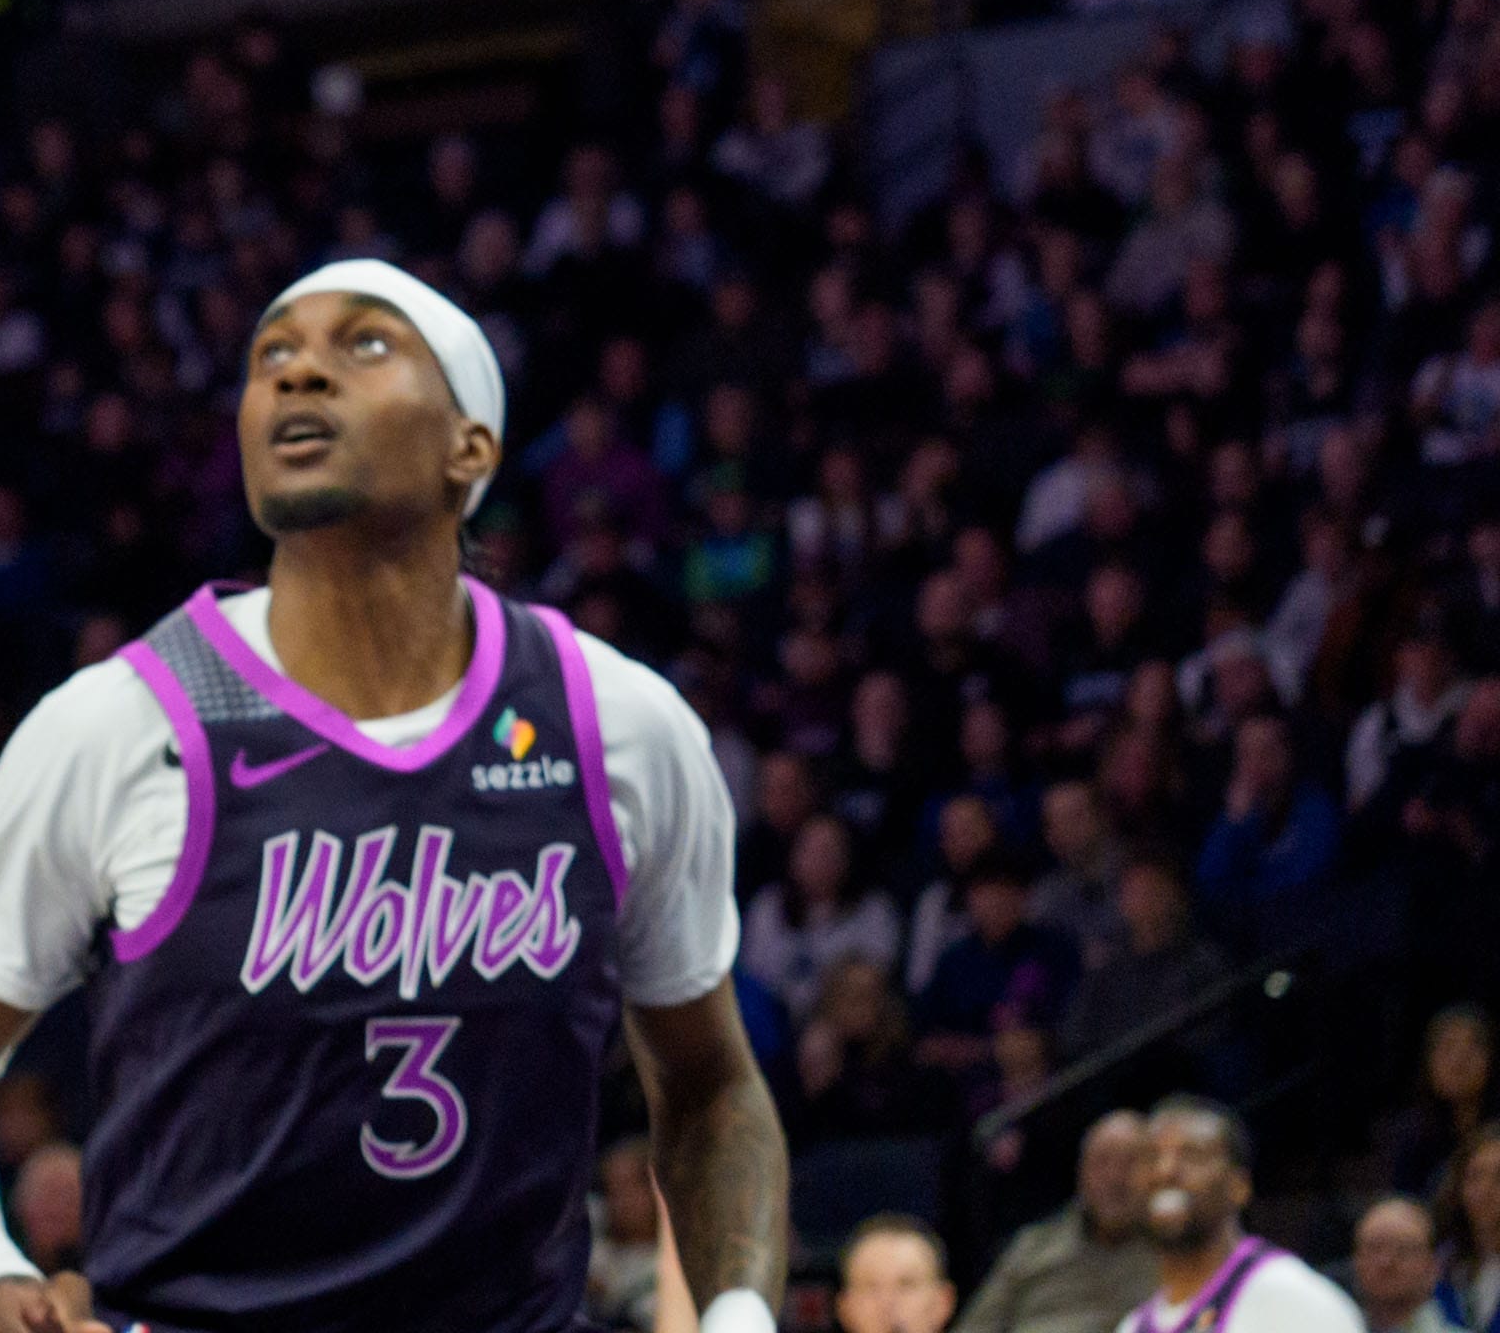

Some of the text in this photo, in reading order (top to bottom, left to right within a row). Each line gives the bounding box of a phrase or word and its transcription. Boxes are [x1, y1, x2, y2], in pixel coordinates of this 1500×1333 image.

[471, 754, 575, 791] sezzle
[240, 825, 581, 1000] Wolves
[360, 1016, 468, 1179] 3
